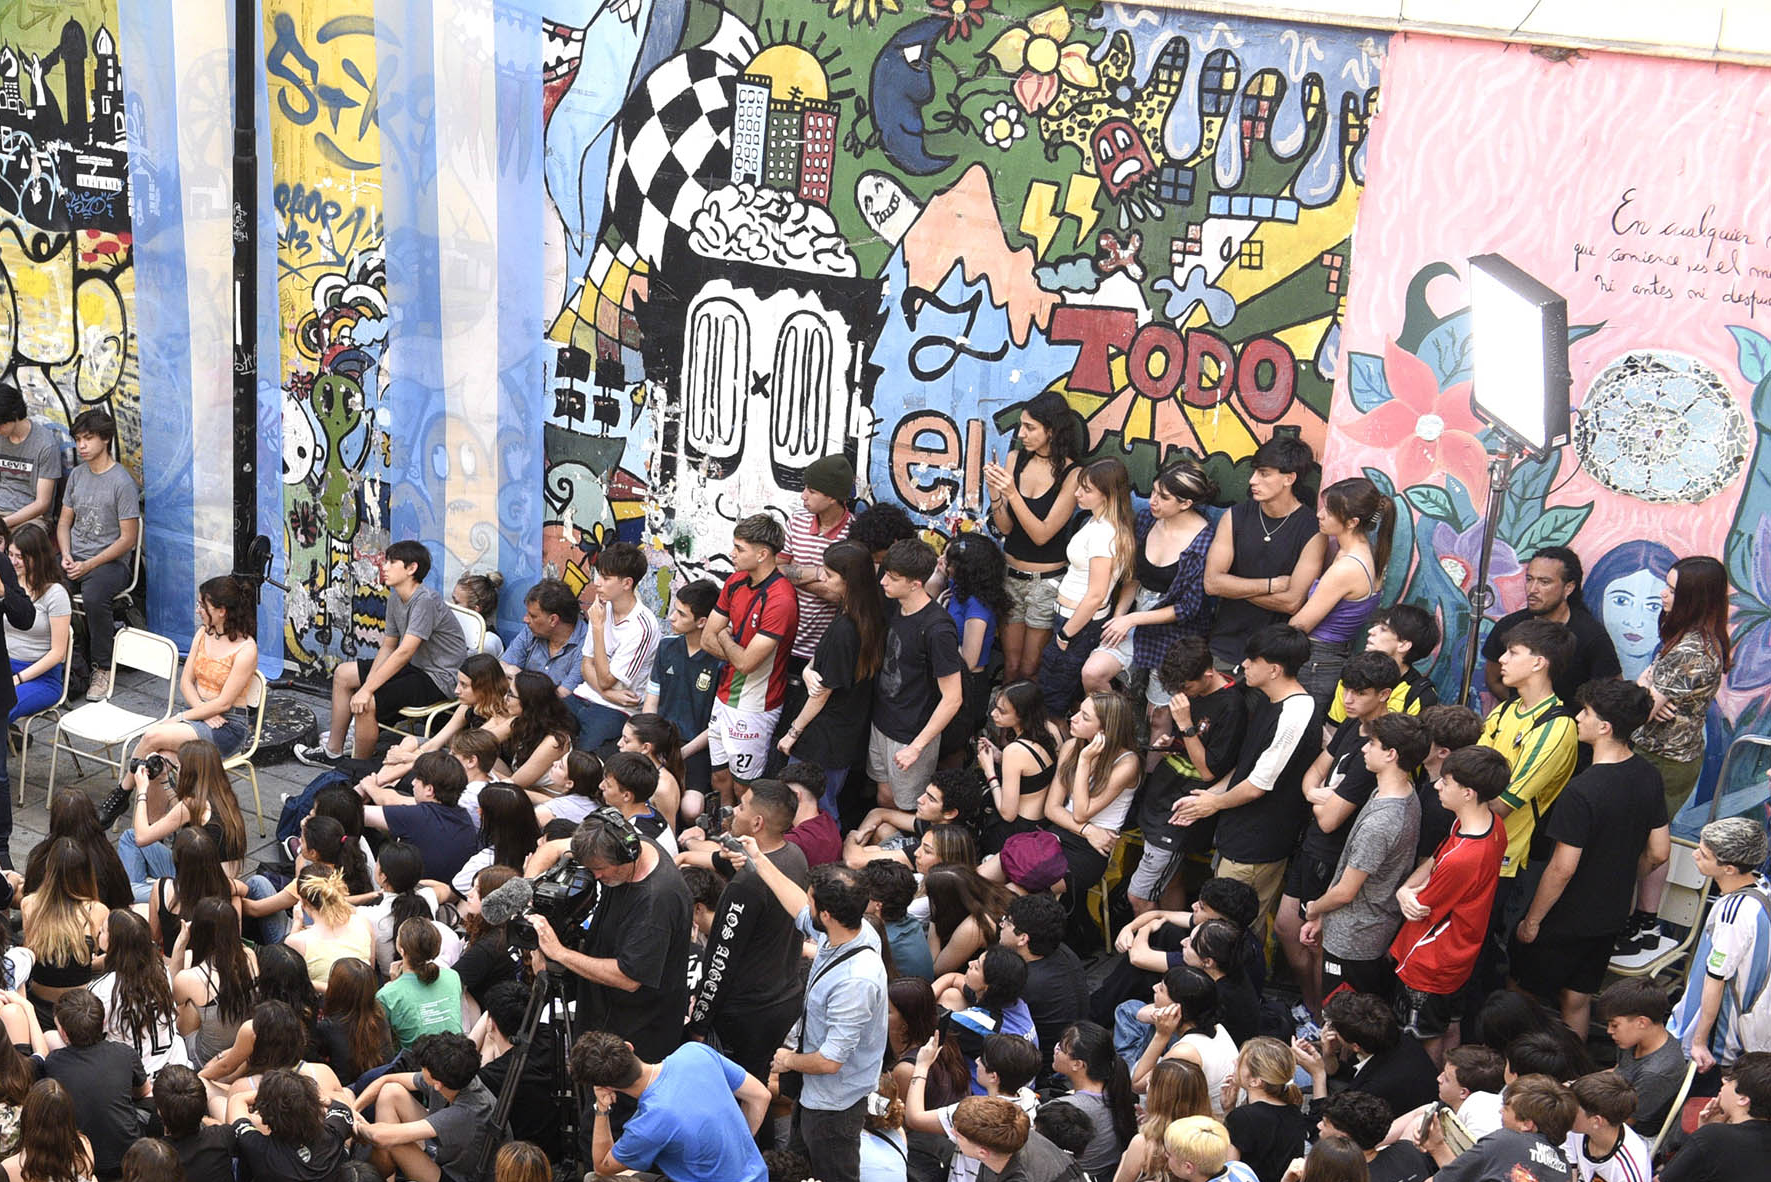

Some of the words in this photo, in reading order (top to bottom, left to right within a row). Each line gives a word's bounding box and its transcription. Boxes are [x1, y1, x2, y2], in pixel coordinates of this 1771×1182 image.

[1612, 187, 1651, 236] En
[1659, 203, 1757, 259] cualquier
[1573, 243, 1597, 273] que
[1714, 249, 1741, 276] el
[1632, 273, 1675, 300] antes
[1687, 287, 1709, 301] ni
[1046, 303, 1298, 425] TODO
[736, 753, 753, 768] 27
[722, 901, 745, 941] LOS
